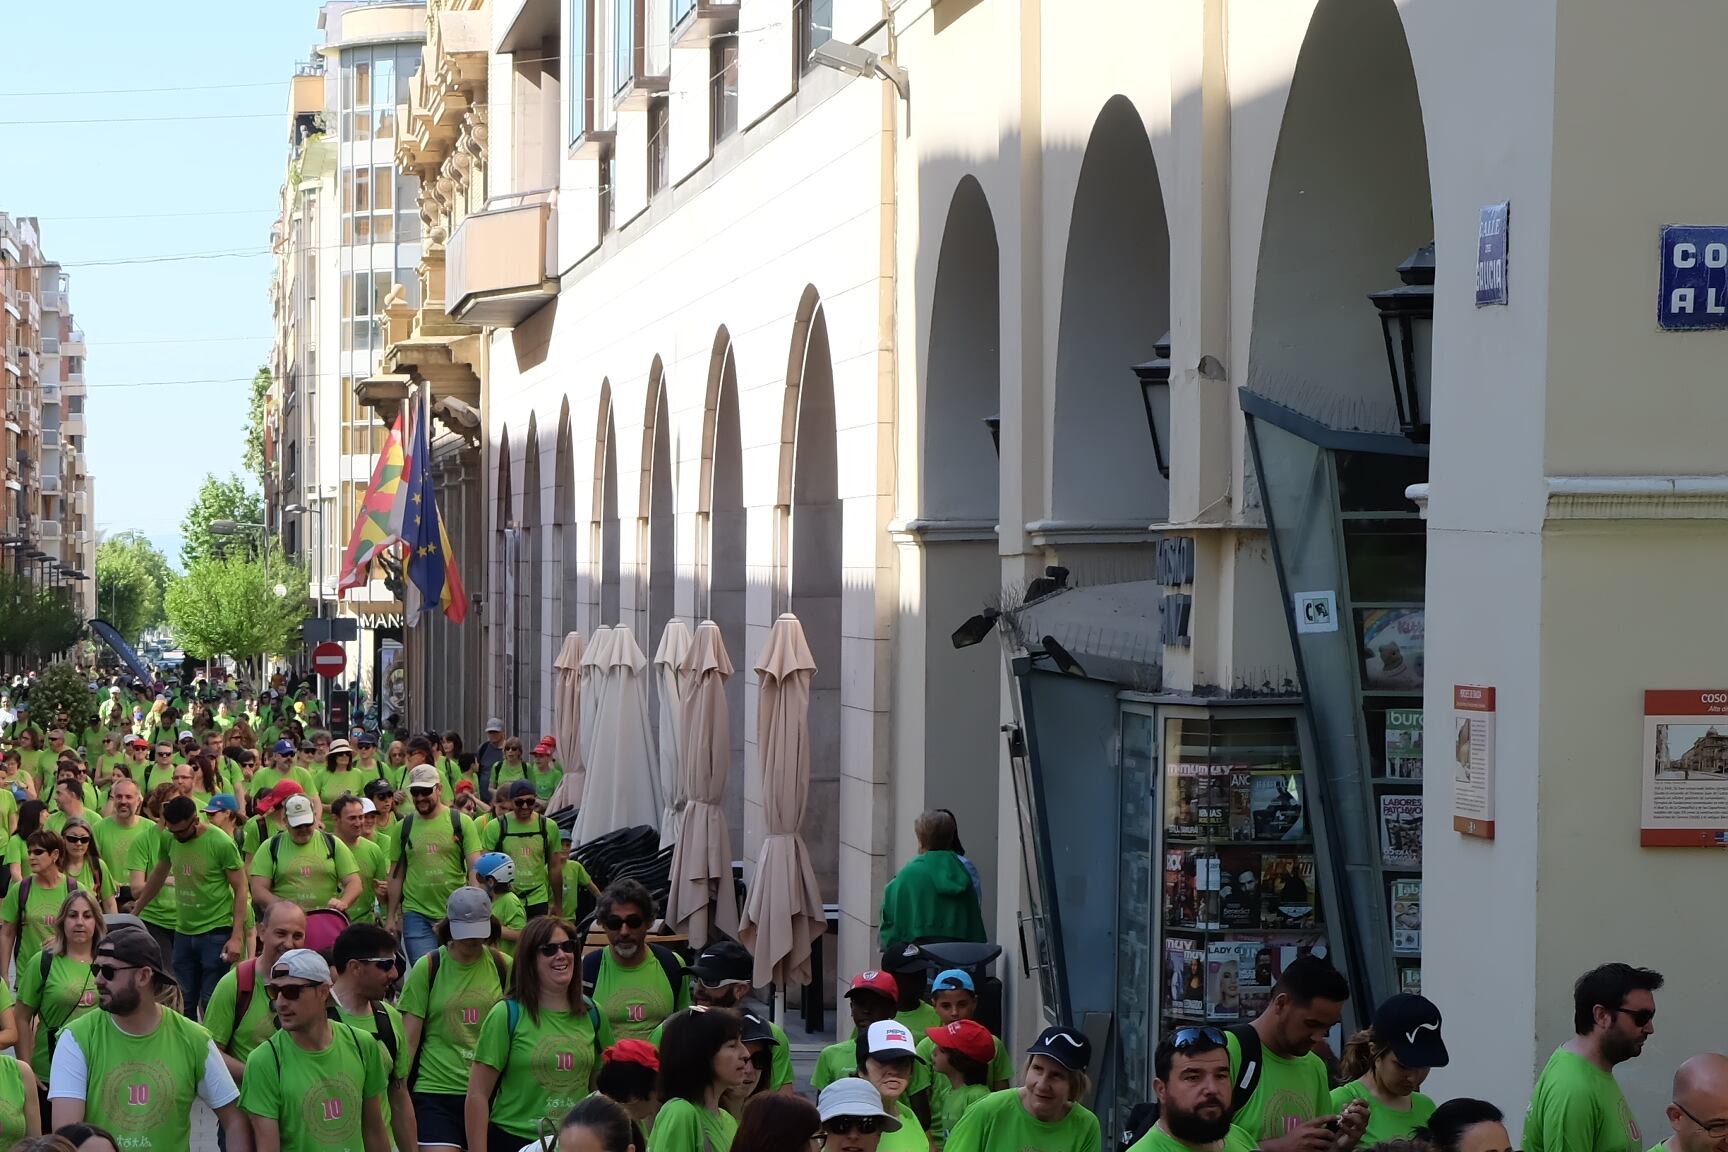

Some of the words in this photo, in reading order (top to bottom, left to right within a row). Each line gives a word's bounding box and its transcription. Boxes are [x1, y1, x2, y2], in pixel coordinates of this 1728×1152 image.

[1701, 693, 1727, 703] COSO
[1208, 946, 1231, 954] LADY
[462, 1006, 479, 1025] 10
[628, 1004, 646, 1022] 10
[558, 1052, 574, 1071] 10
[129, 1083, 149, 1106] 10
[323, 1097, 343, 1121] 10
